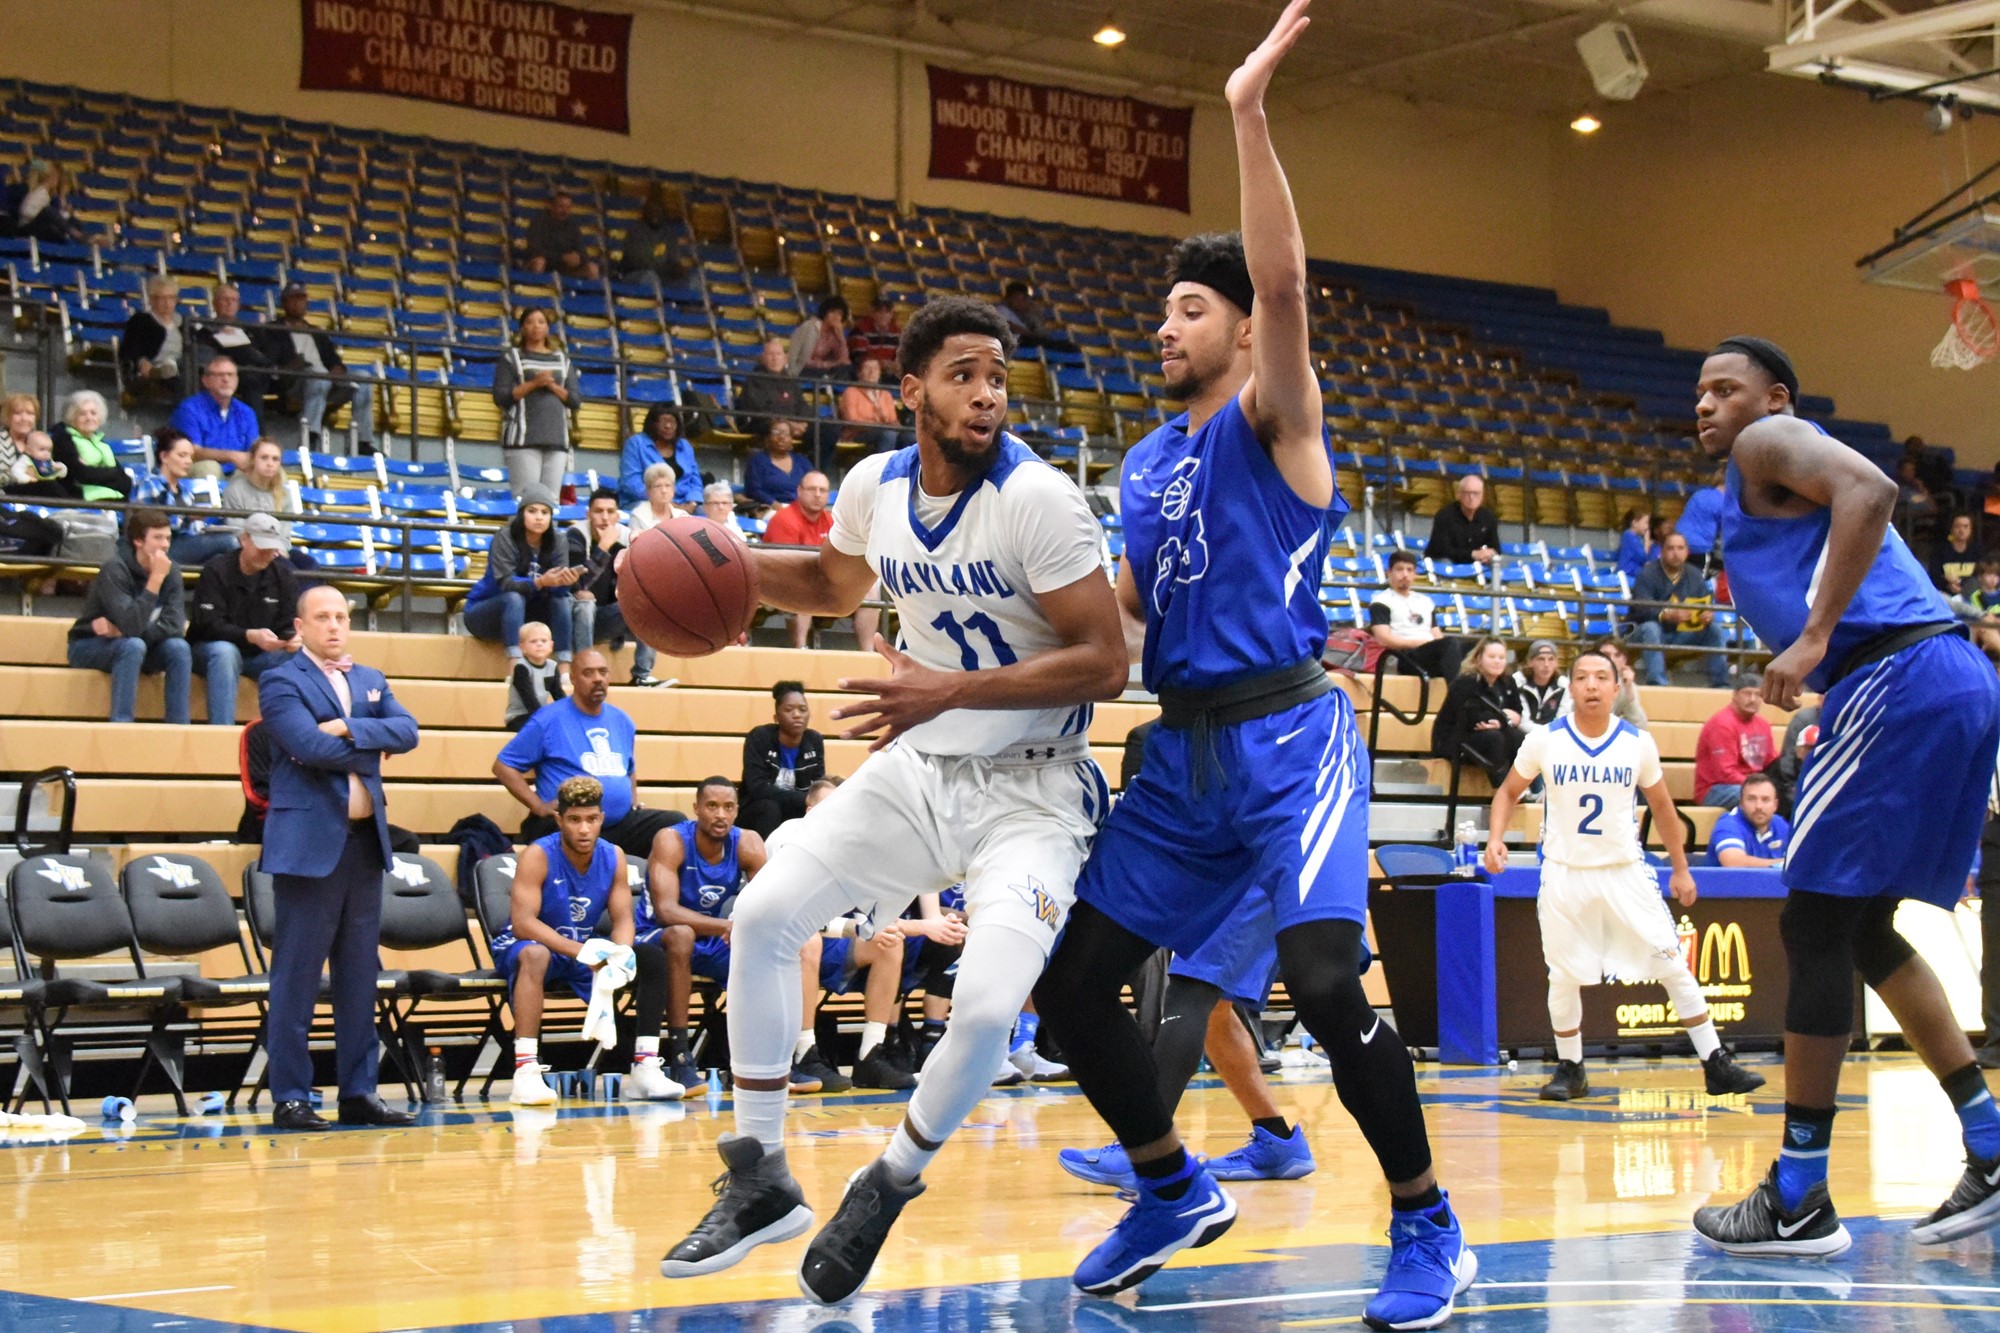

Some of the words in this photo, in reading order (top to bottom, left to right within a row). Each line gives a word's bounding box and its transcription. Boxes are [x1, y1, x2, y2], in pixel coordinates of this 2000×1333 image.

[315, 2, 407, 42] INDOOR
[417, 17, 494, 56] TRACK
[503, 32, 550, 64] AND
[556, 40, 617, 74] FIELD
[474, 84, 557, 117] DIVISION
[988, 80, 1033, 112] NAIA
[1047, 91, 1137, 127] NATIONAL
[936, 99, 1008, 134] INDOOR
[1017, 112, 1081, 145] TRACK
[1090, 125, 1128, 151] AND
[1135, 133, 1185, 161] FIELD
[1005, 160, 1048, 187] MENS
[1056, 168, 1122, 198] DIVISION
[880, 555, 1016, 599] WAYLAND
[930, 610, 1018, 671] 11
[1553, 764, 1632, 788] WAYLAND
[1577, 793, 1603, 836] 2
[1616, 1003, 1665, 1028] open
[1706, 1001, 1746, 1022] ours
